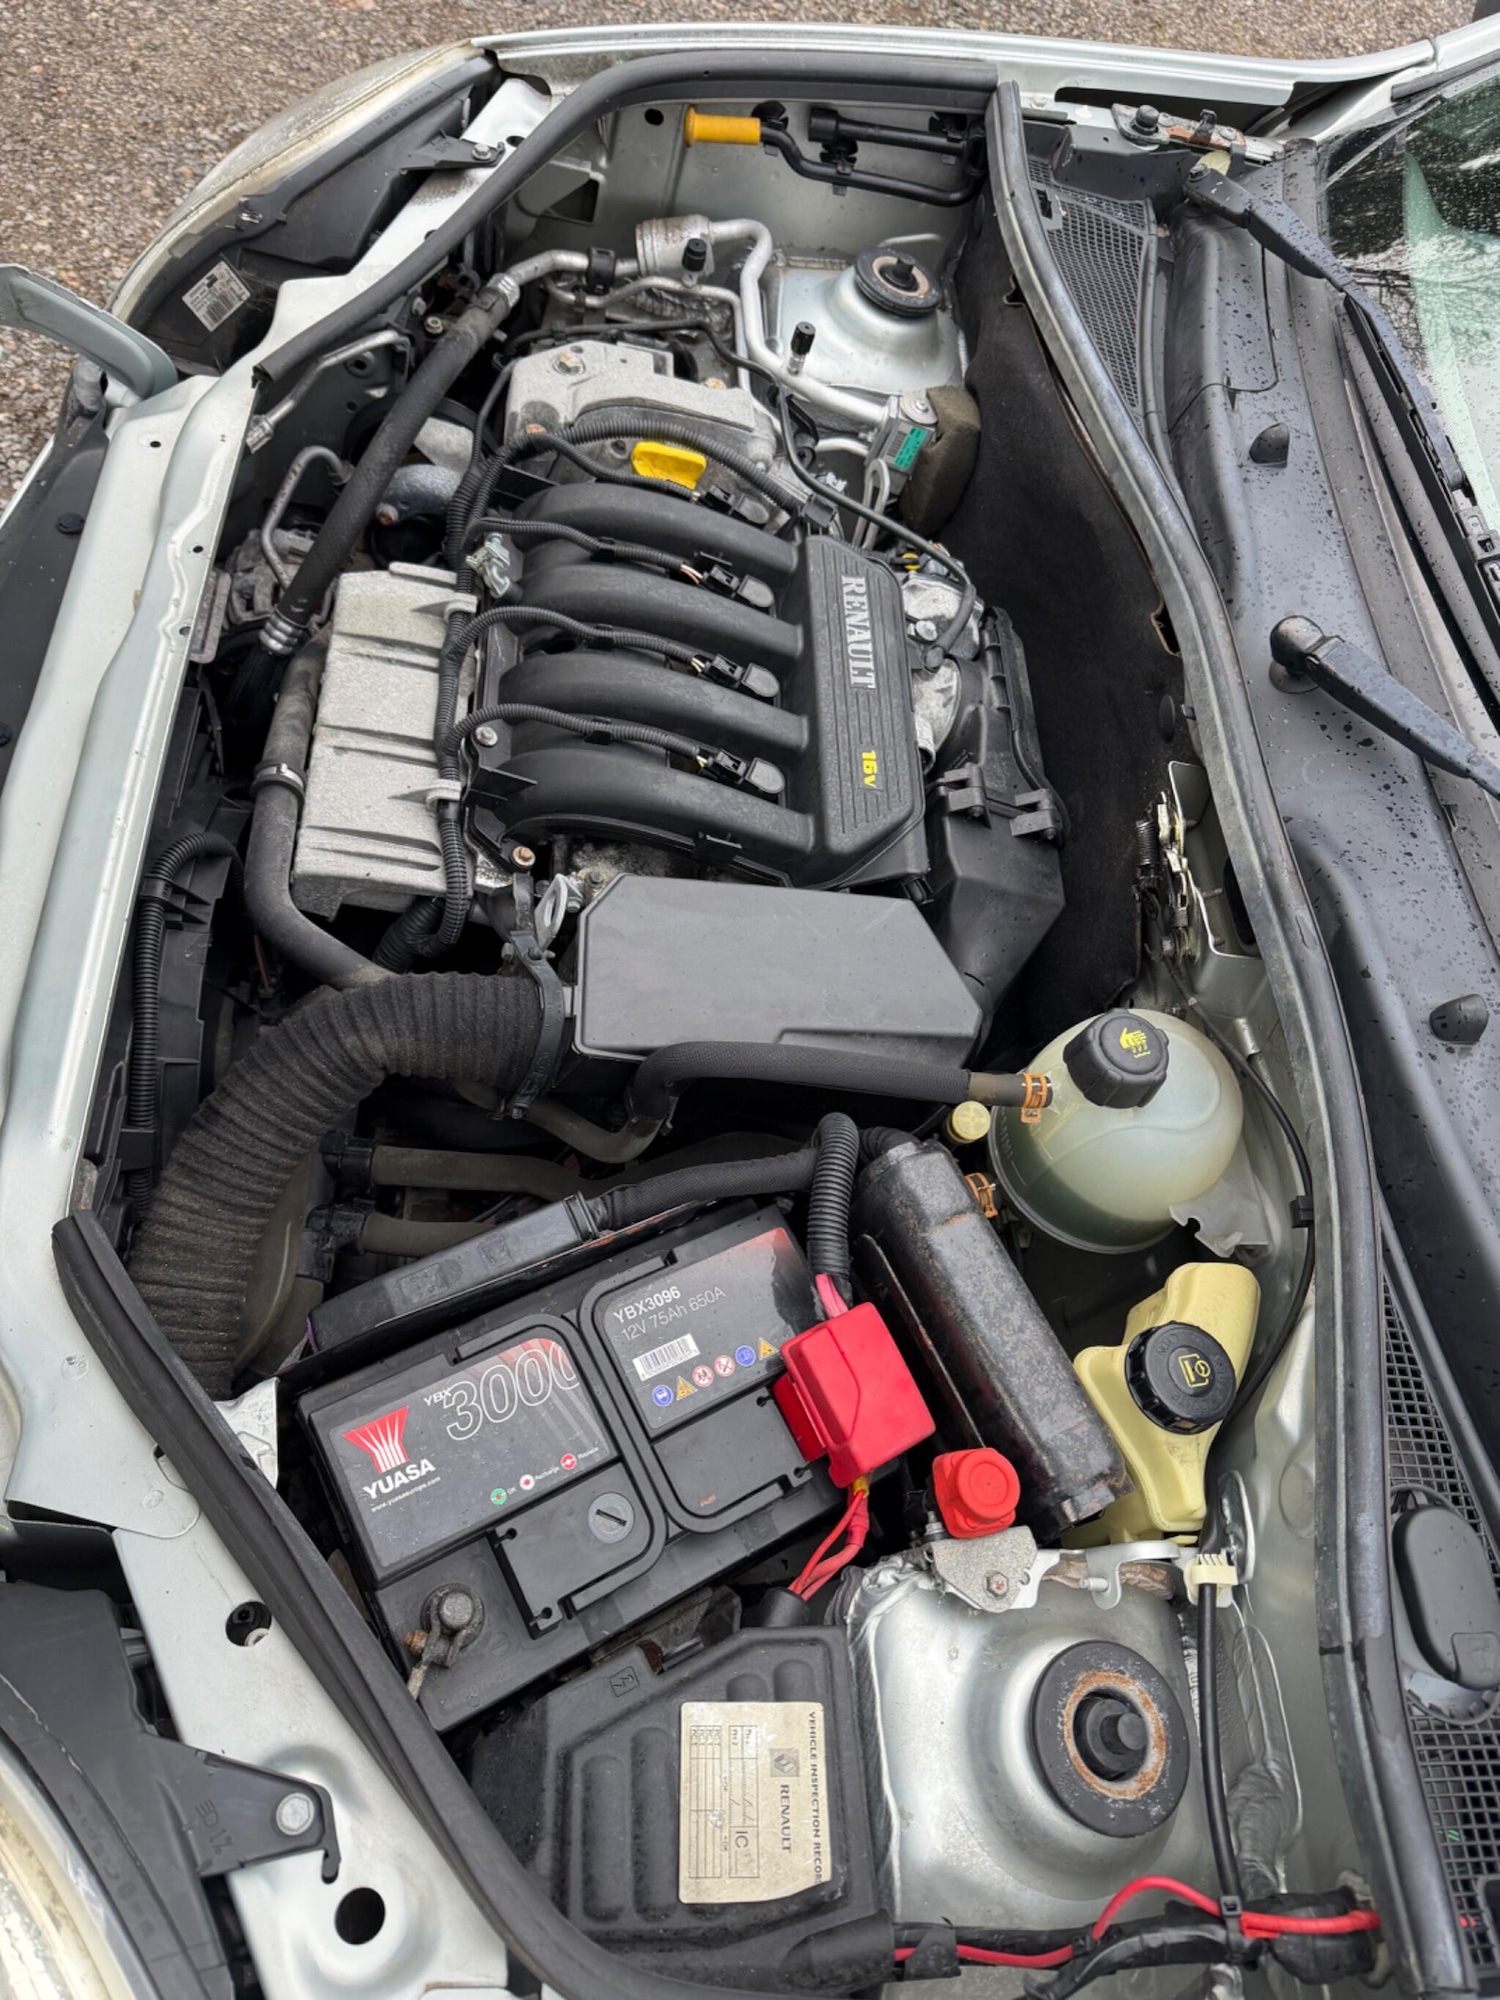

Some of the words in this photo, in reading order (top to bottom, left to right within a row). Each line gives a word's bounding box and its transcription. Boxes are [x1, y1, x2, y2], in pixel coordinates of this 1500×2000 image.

[841, 575, 876, 689] RENAULT
[861, 750, 877, 788] 16v
[613, 1286, 681, 1323] YBX3096
[621, 1319, 647, 1340] 12V
[648, 1305, 688, 1328] 75Ah
[688, 1286, 726, 1311] 650A
[423, 1387, 452, 1406] YBX
[362, 1458, 436, 1499] YUASA
[808, 1711, 817, 1759] VEHICLE
[780, 1784, 791, 1853] RENAULT
[810, 1764, 820, 1838] INSPECTION
